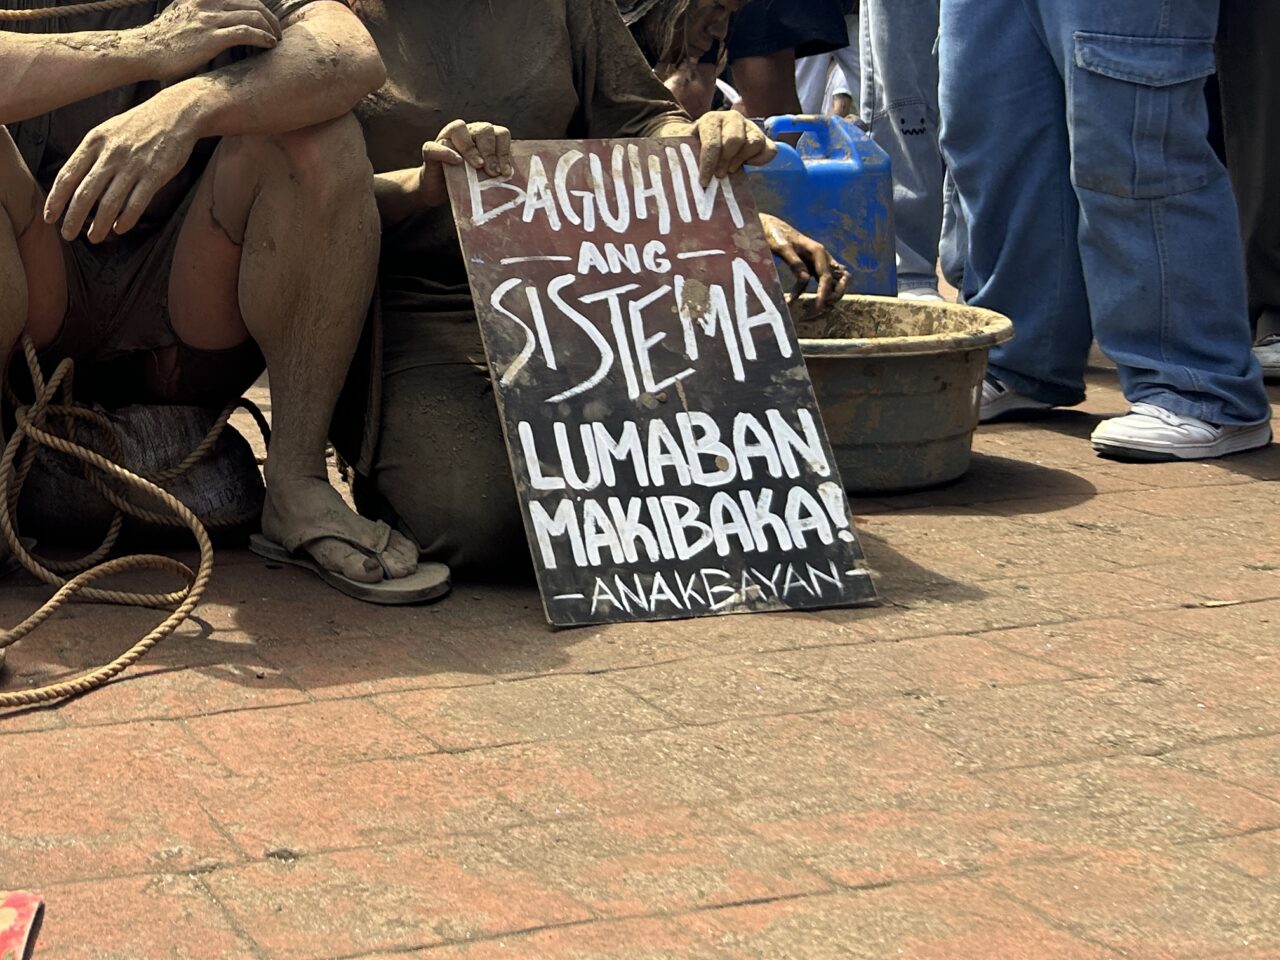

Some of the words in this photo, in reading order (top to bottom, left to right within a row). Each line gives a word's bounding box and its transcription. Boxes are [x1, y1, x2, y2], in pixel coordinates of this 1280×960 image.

[577, 240, 672, 275] ANG
[491, 257, 792, 403] SISTEMA
[518, 407, 832, 491] LUMABAN
[528, 481, 856, 569] MAKIBAKA!
